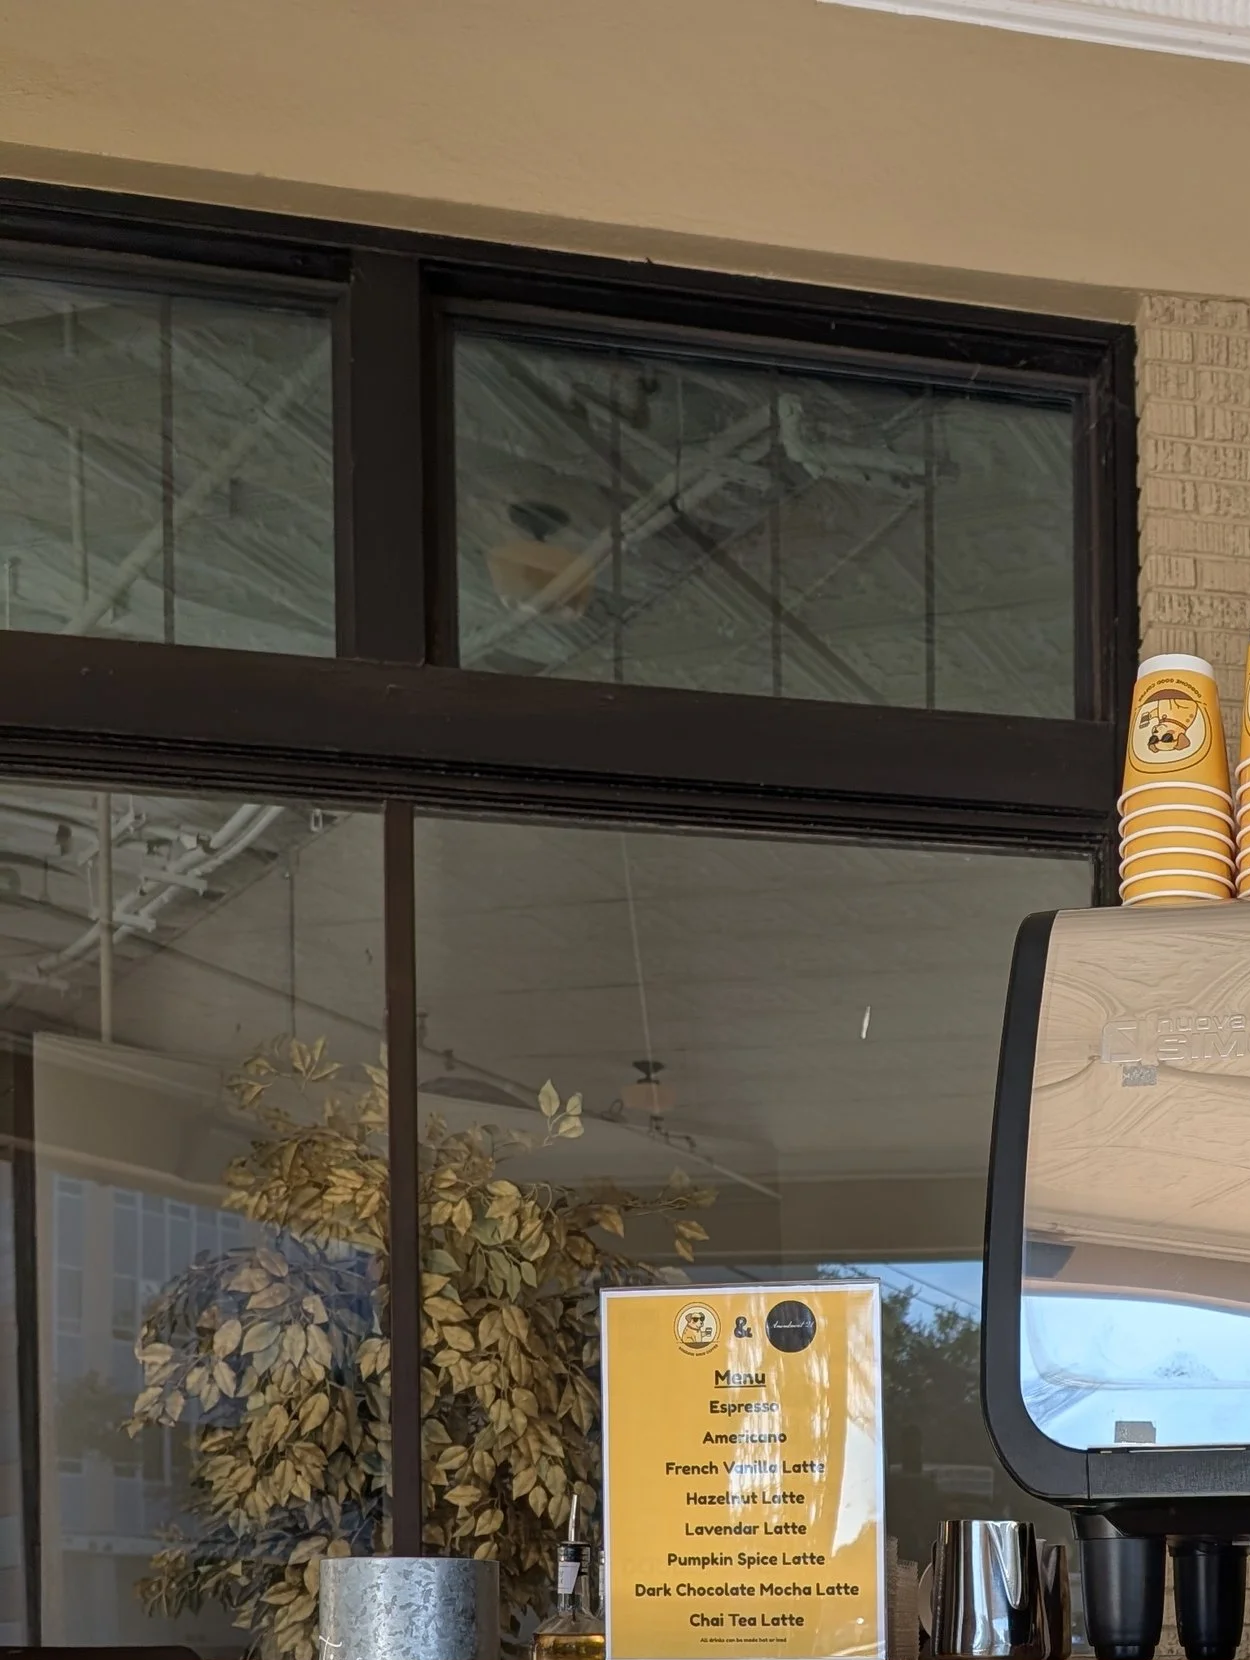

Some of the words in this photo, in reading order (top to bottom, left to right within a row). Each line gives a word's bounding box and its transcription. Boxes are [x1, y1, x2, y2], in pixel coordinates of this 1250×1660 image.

[1157, 1014, 1247, 1033] nuova
[714, 1369, 766, 1386] Menu
[709, 1400, 779, 1417] Espresso
[702, 1431, 787, 1444] Americano
[665, 1461, 719, 1476] French
[723, 1461, 778, 1475] Vanilla
[782, 1460, 825, 1474] Latte
[686, 1491, 758, 1505] Hazelnut
[762, 1491, 805, 1505] Latte
[685, 1522, 760, 1536] Lavendar
[764, 1521, 807, 1535] Latte
[667, 1552, 733, 1569] Pumpkin
[737, 1552, 778, 1569] Spice
[782, 1552, 826, 1566] Latte
[634, 1583, 672, 1597] Dark
[676, 1582, 756, 1596] Chocolate
[759, 1582, 812, 1596] Mocha
[816, 1582, 860, 1596] Latte
[689, 1613, 724, 1627] Chai
[728, 1613, 757, 1627] Tea
[761, 1613, 805, 1626] Latte
